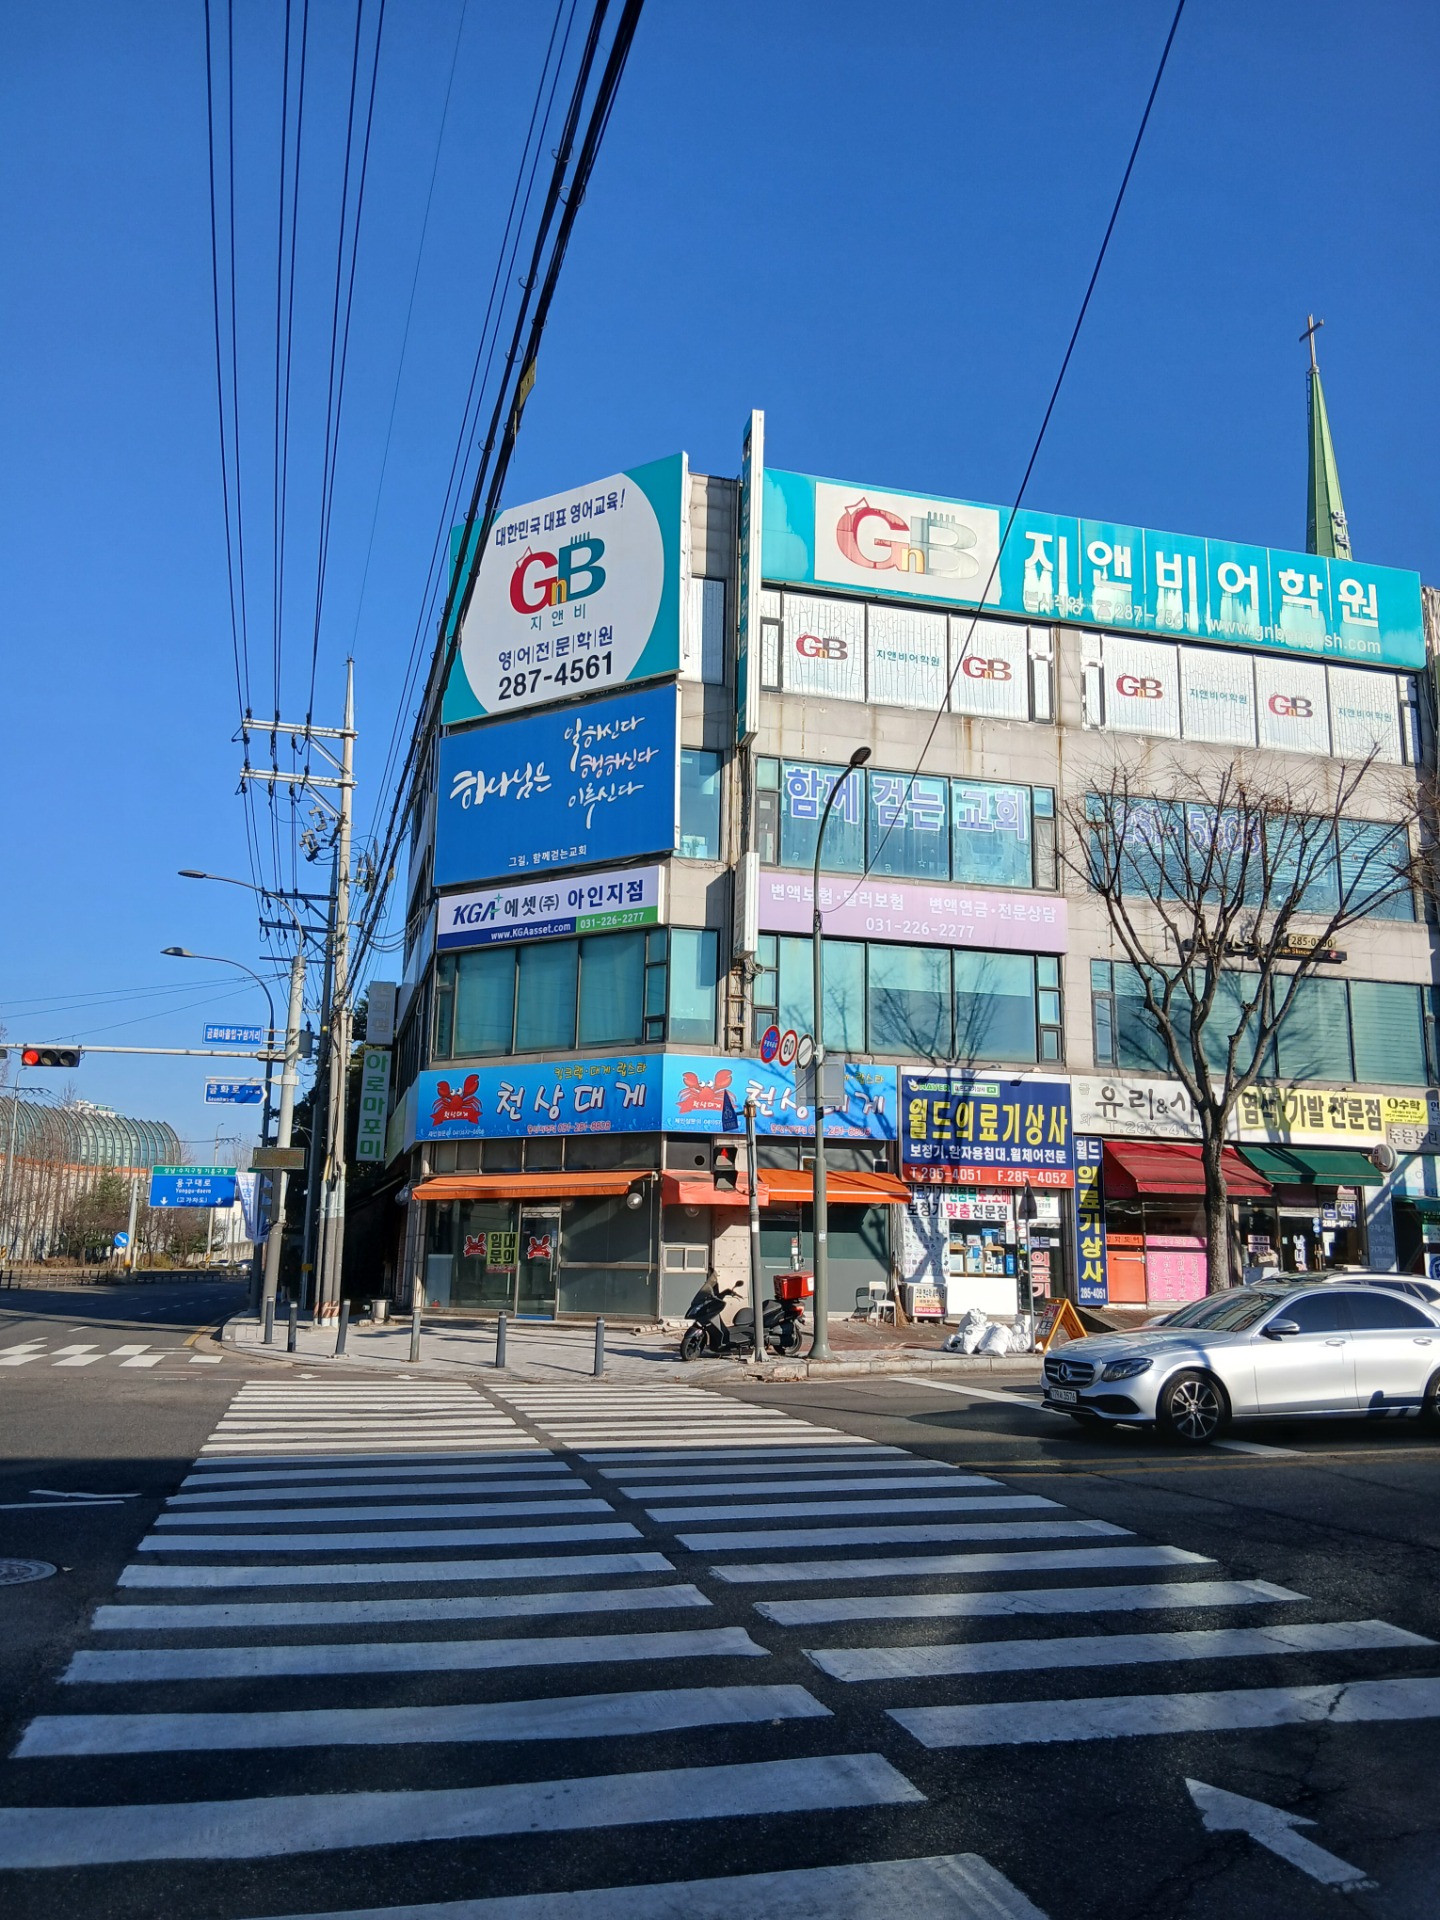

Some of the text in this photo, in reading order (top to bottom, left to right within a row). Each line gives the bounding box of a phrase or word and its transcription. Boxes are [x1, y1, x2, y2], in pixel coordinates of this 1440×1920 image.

[495, 488, 626, 547] 대한민국 대표 영어교육!
[836, 506, 980, 580] GnB
[510, 535, 607, 615] GnB
[795, 633, 848, 661] GnB
[876, 649, 940, 667] 지앤비어학원
[498, 651, 613, 700] 287-4561
[962, 655, 1012, 682] GnB
[1115, 675, 1164, 700] GnB
[1189, 688, 1248, 705] 지앤비어학원
[1268, 694, 1314, 718] GnB
[563, 715, 646, 772] 일하신다
[449, 761, 553, 810] 하나님은
[567, 781, 645, 830] 이루신다
[785, 766, 1027, 841] 함께 걷는 교회
[504, 879, 644, 918] 에셋(주) 아인지점
[490, 922, 571, 941] www.KGAasset.com
[579, 911, 645, 929] 031-226-2277
[865, 916, 975, 939] 031-226-2277
[783, 1039, 795, 1056] 60
[208, 1084, 241, 1095] 금화로
[495, 1081, 647, 1121] 천상대게
[360, 1054, 388, 1158] 아로마포미
[1329, 1096, 1382, 1131] 전문점
[909, 1098, 1068, 1146] 월드의료기상사
[1076, 1140, 1100, 1160] 월드
[175, 1178, 212, 1188] 용구대로
[911, 1166, 1067, 1184] T.285-4051 F.285-4052
[906, 1202, 1008, 1220] 보청기 맞춤 전문점
[1077, 1166, 1104, 1283] 의료기상사
[490, 1233, 516, 1249] 임대
[490, 1249, 515, 1264] 문의
[1080, 1287, 1106, 1299] 285-4051
